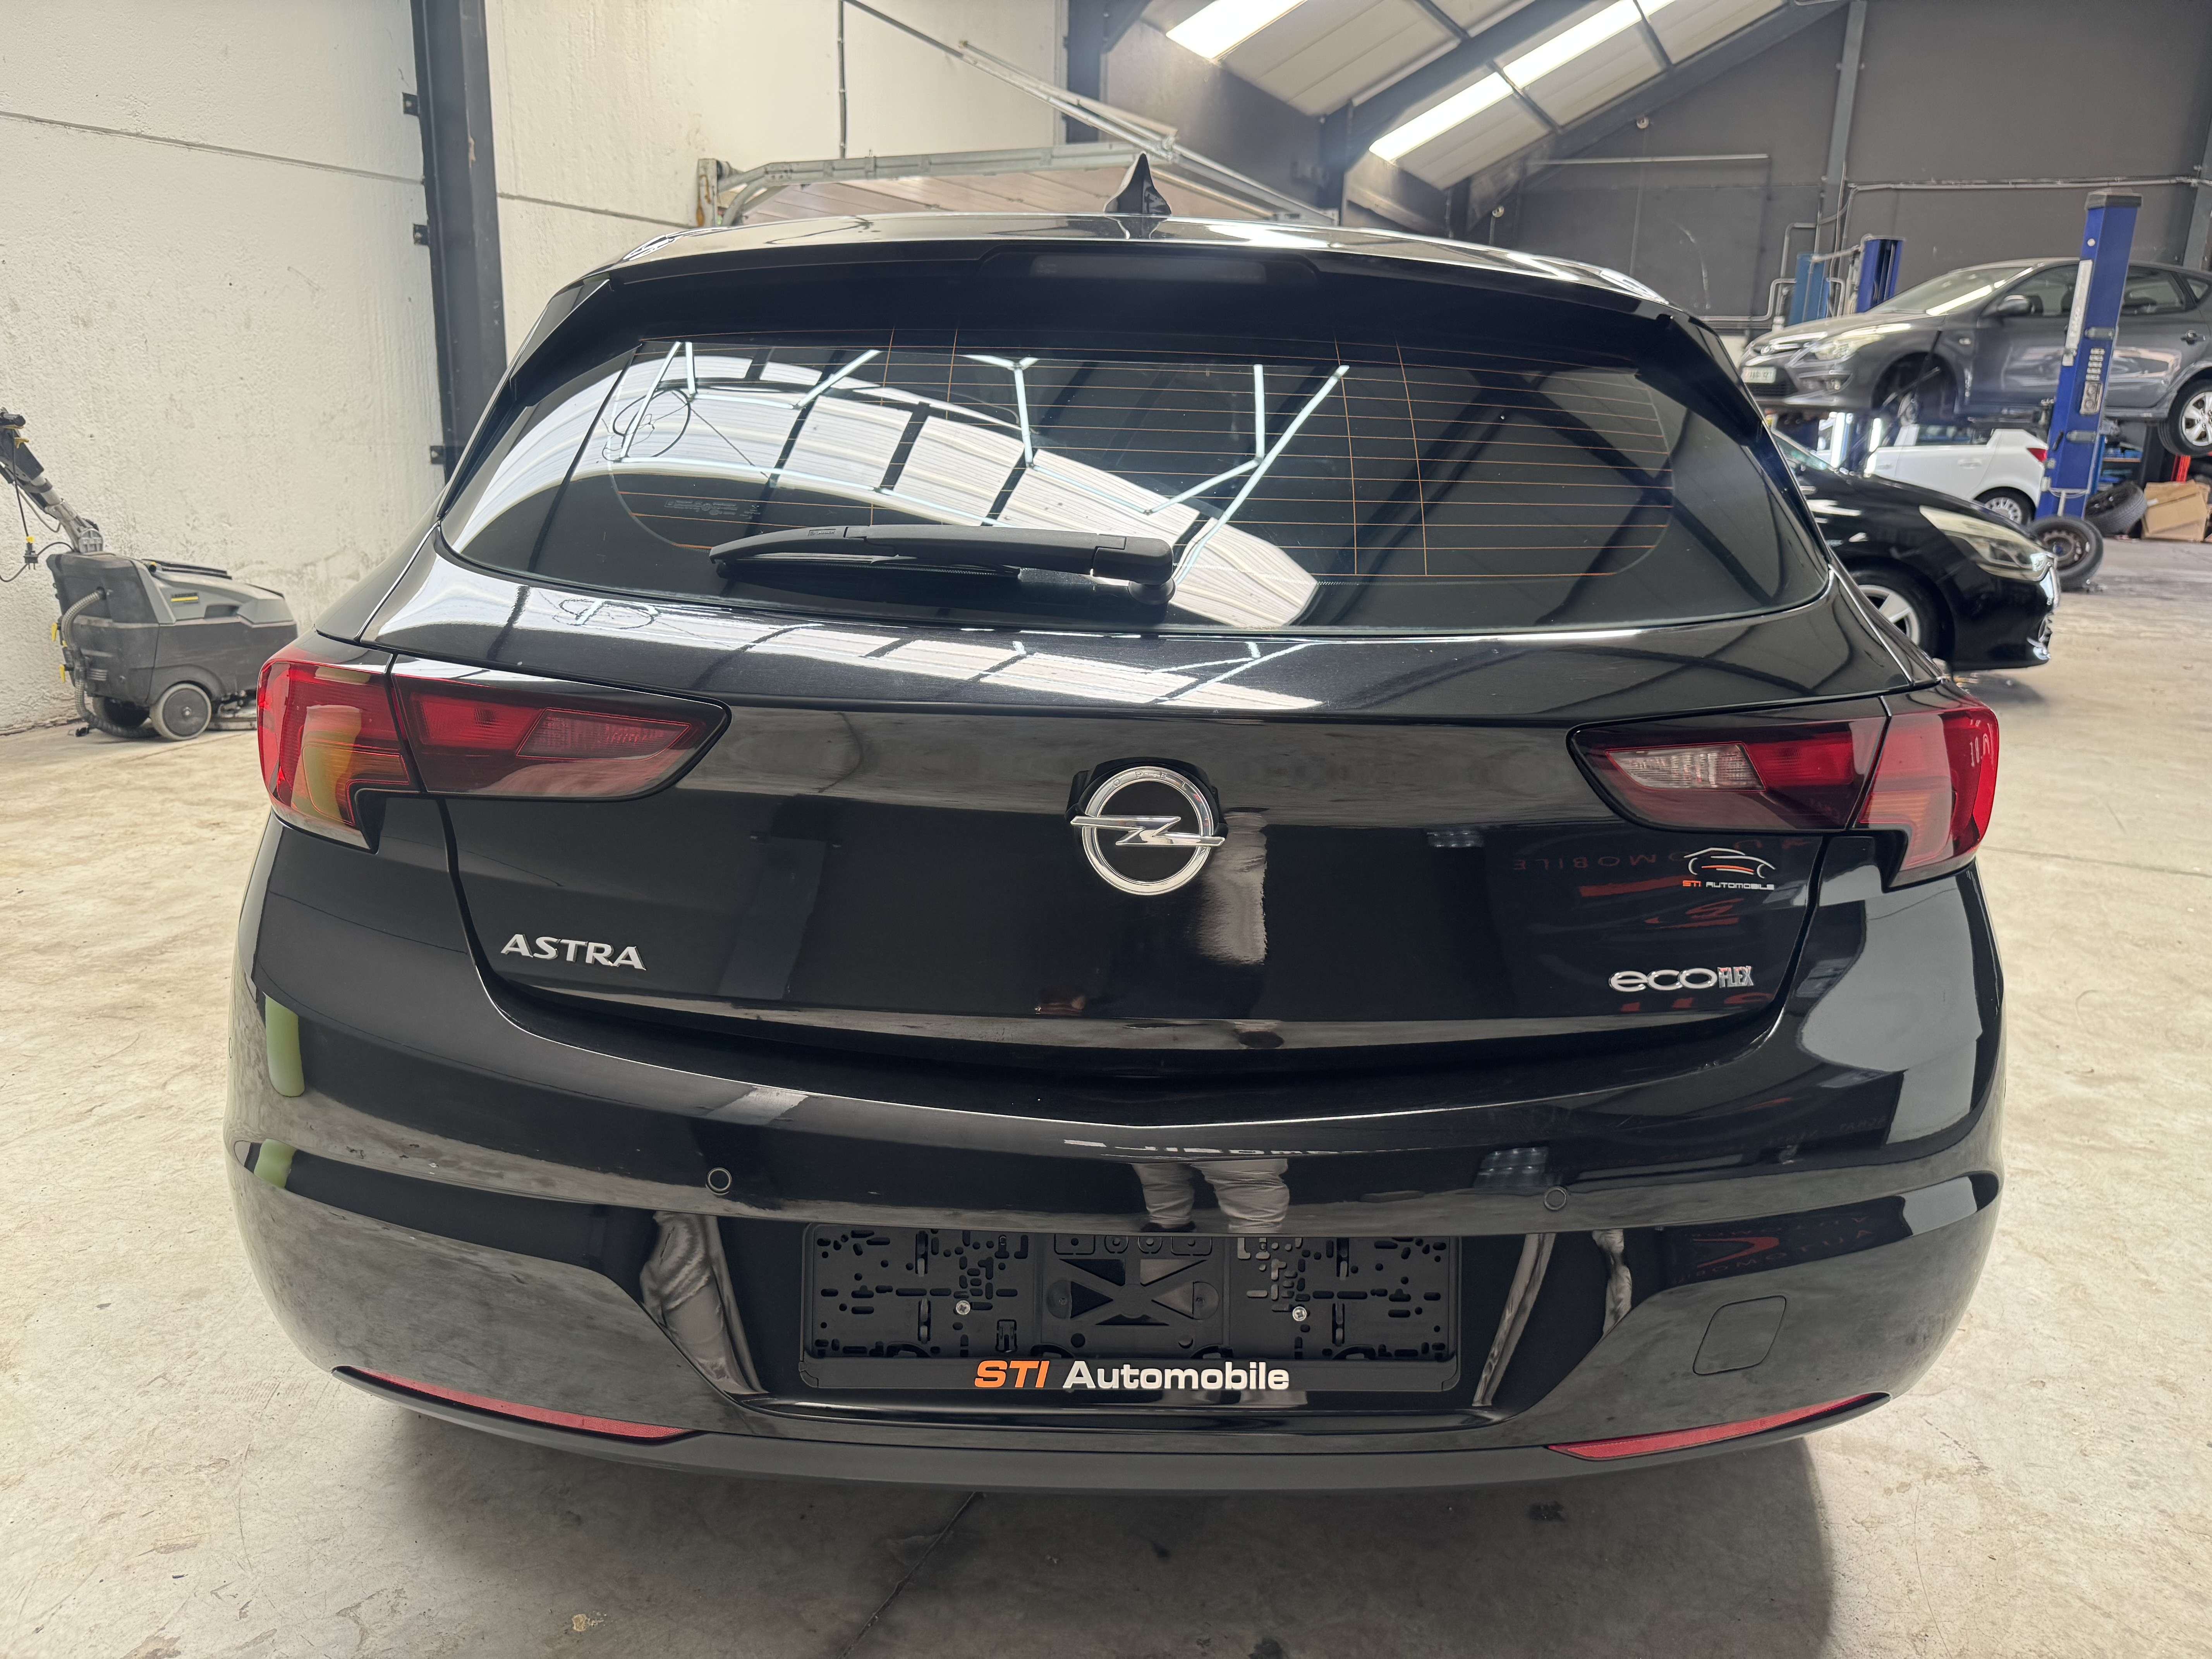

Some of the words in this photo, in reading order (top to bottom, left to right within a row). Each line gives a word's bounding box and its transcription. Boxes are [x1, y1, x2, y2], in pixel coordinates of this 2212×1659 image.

[1706, 881, 1774, 890] AUTOMOBILE
[501, 933, 646, 970] ASTRA
[974, 1360, 1050, 1388] STI
[1063, 1360, 1290, 1390] Automobile
